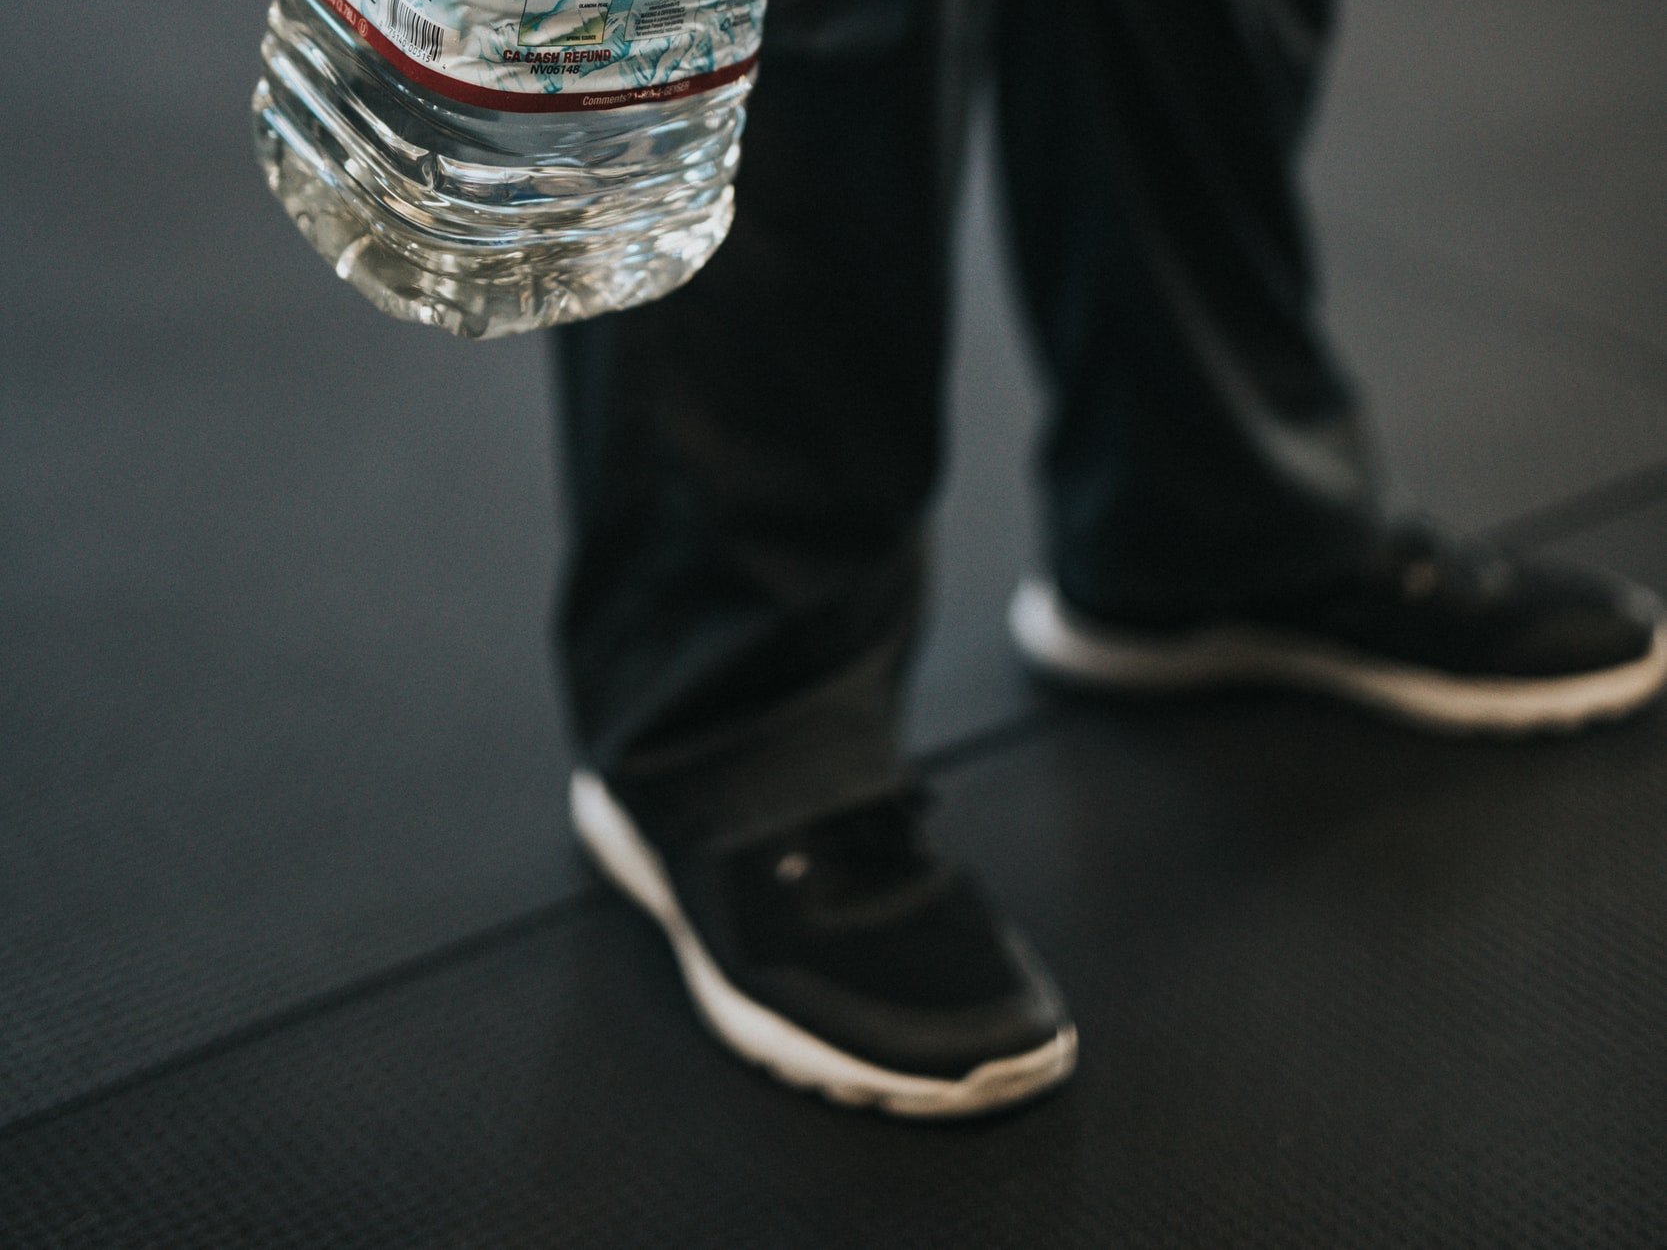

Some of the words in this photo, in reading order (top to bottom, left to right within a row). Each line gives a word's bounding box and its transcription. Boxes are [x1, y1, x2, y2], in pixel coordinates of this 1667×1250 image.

[503, 49, 521, 62] CA
[525, 51, 561, 63] CASH
[563, 49, 612, 63] REFUND
[530, 64, 580, 75] NV06148
[582, 92, 632, 106] Comments?
